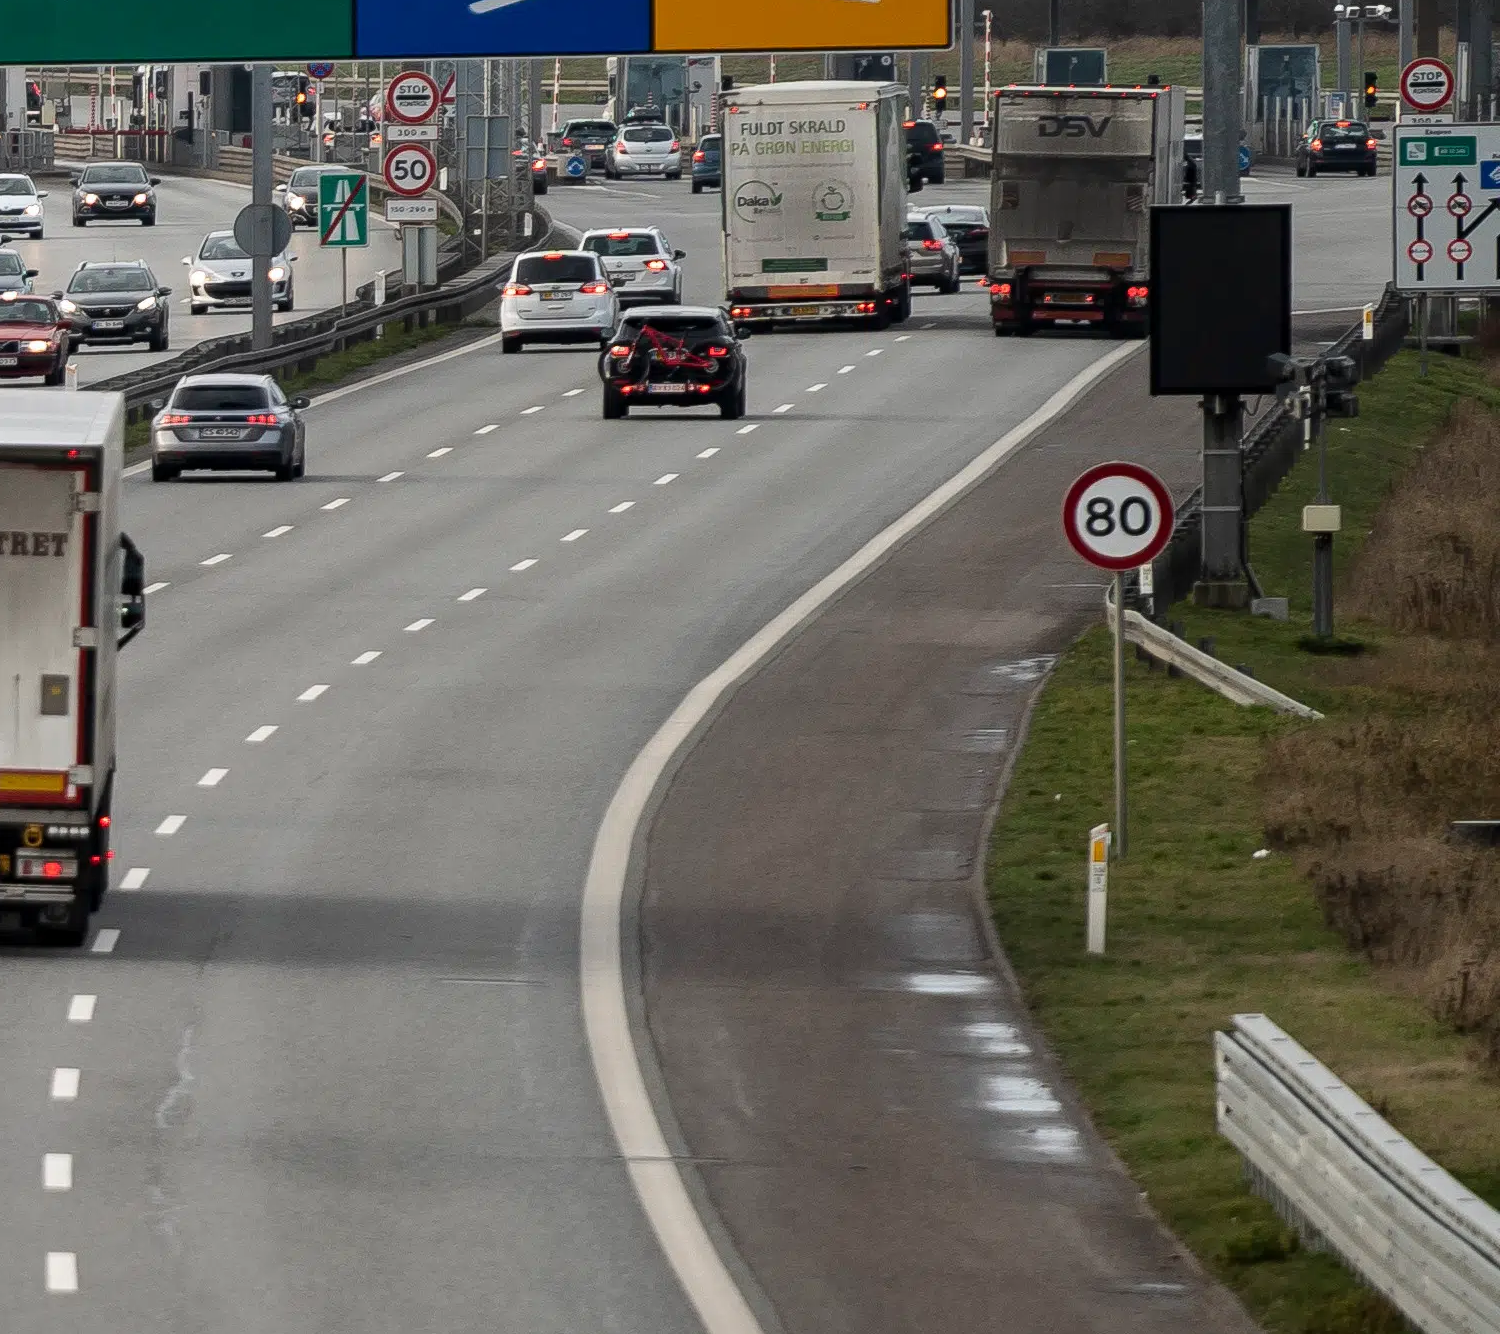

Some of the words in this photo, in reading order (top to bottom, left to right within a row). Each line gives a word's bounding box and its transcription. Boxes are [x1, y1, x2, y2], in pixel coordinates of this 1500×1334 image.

[1412, 71, 1443, 82] STOP
[399, 85, 429, 94] STOP
[741, 121, 785, 136] FULDT
[789, 119, 846, 134] SKRALD
[1037, 115, 1114, 138] DSV
[730, 137, 750, 156] PÅ
[755, 140, 796, 155] GRØN
[800, 139, 855, 154] ENERGI
[393, 159, 427, 181] 50
[737, 195, 770, 207] Daka
[1085, 495, 1152, 537] 80
